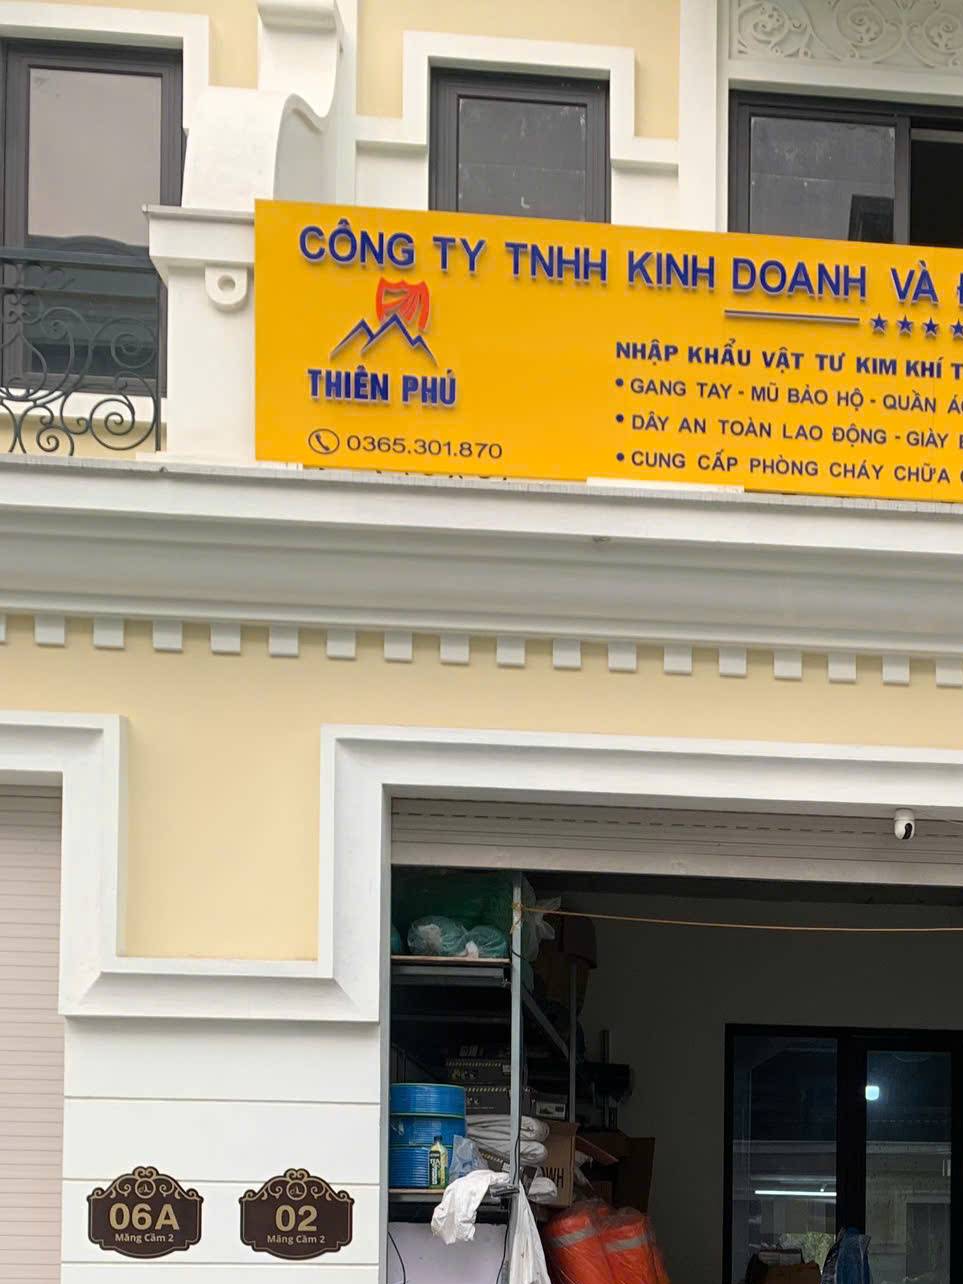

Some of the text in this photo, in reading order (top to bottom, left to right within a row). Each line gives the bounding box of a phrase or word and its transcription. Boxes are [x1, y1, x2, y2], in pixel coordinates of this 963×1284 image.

[299, 218, 416, 269] CÔNG
[432, 235, 486, 273] TY
[504, 241, 607, 283] TNHH
[627, 250, 716, 290] KINH
[731, 257, 867, 299] DOANH
[890, 259, 939, 304] VÀ
[615, 339, 679, 366] NHẬP
[687, 338, 751, 367] KHẨU
[761, 347, 804, 374] VẬT
[815, 352, 846, 372] TƯ
[856, 356, 897, 376] KIM
[905, 356, 944, 379] KHÍ
[307, 365, 456, 406] THIÊN PHÚ
[630, 378, 687, 397] GANG
[697, 382, 732, 399] TAY
[751, 382, 779, 402] MŨ
[788, 384, 828, 405] BẢO
[837, 387, 864, 411] HỘ
[883, 389, 937, 413] QUẦN
[346, 435, 503, 459] 0365.301.870
[632, 411, 670, 431] DÂY
[678, 418, 706, 434] AN
[718, 417, 771, 438] TOÀN
[783, 424, 823, 441] LAO
[832, 423, 887, 447] ĐỘNG
[906, 428, 949, 449] GIÀY
[631, 450, 686, 469] CUNG
[698, 449, 739, 472] CẤP
[749, 459, 819, 477] PHÒNG
[829, 459, 884, 481] CHÁY
[894, 463, 950, 483] CHỮA
[109, 1202, 180, 1230] 06A
[275, 1204, 318, 1232] 02
[168, 1233, 174, 1242] 2
[319, 1235, 326, 1244] 2
